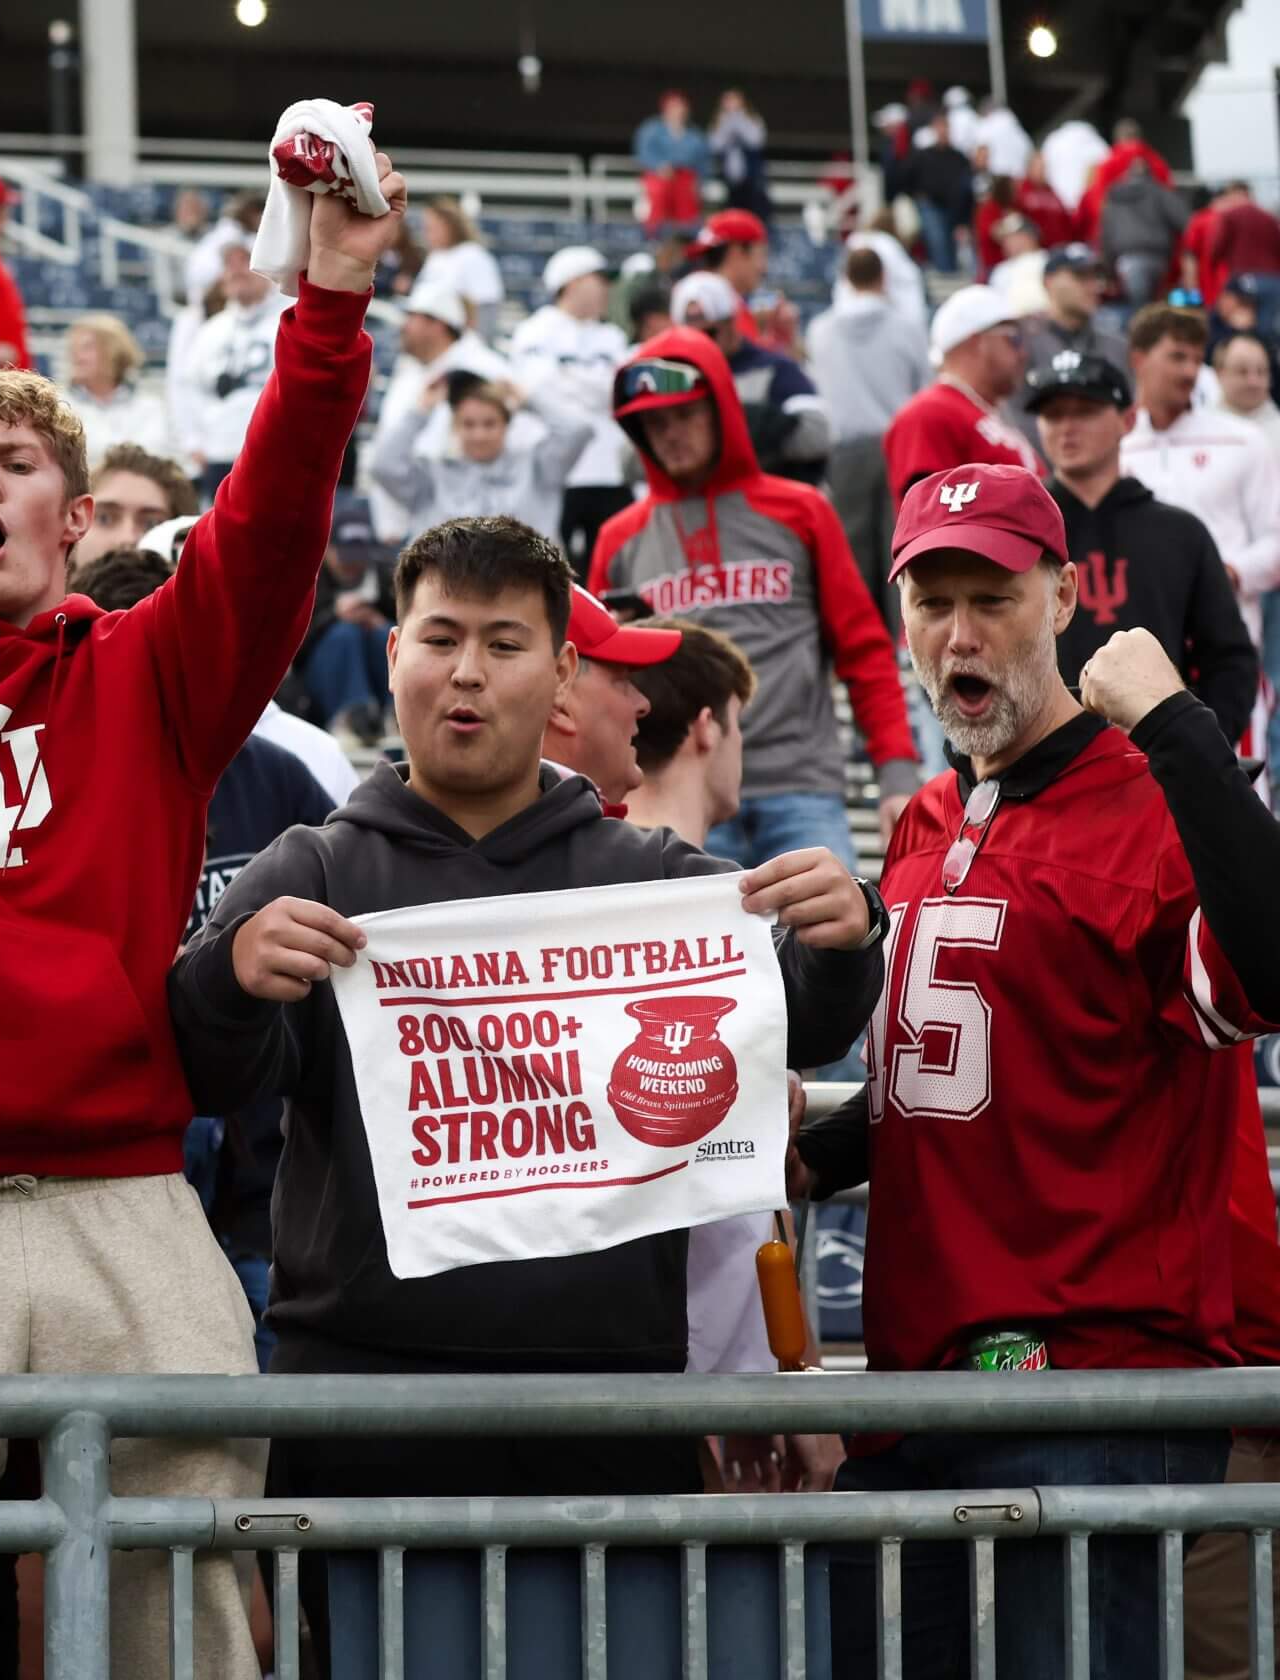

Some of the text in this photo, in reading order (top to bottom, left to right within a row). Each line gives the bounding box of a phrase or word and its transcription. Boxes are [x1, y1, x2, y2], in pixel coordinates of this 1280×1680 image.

[369, 934, 745, 989] INDIANA FOOTBALL
[397, 1009, 584, 1057] 800,000+
[408, 1049, 583, 1112] ALUMNI
[625, 1053, 724, 1078] HOMECOMING
[639, 1074, 707, 1096] WEEKEND
[620, 1089, 726, 1113] Old Brass Spittoon Game
[410, 1100, 598, 1167] STRONG
[695, 1138, 755, 1158] Simtra
[410, 1159, 610, 1190] #POWERED BY HOOSIERS
